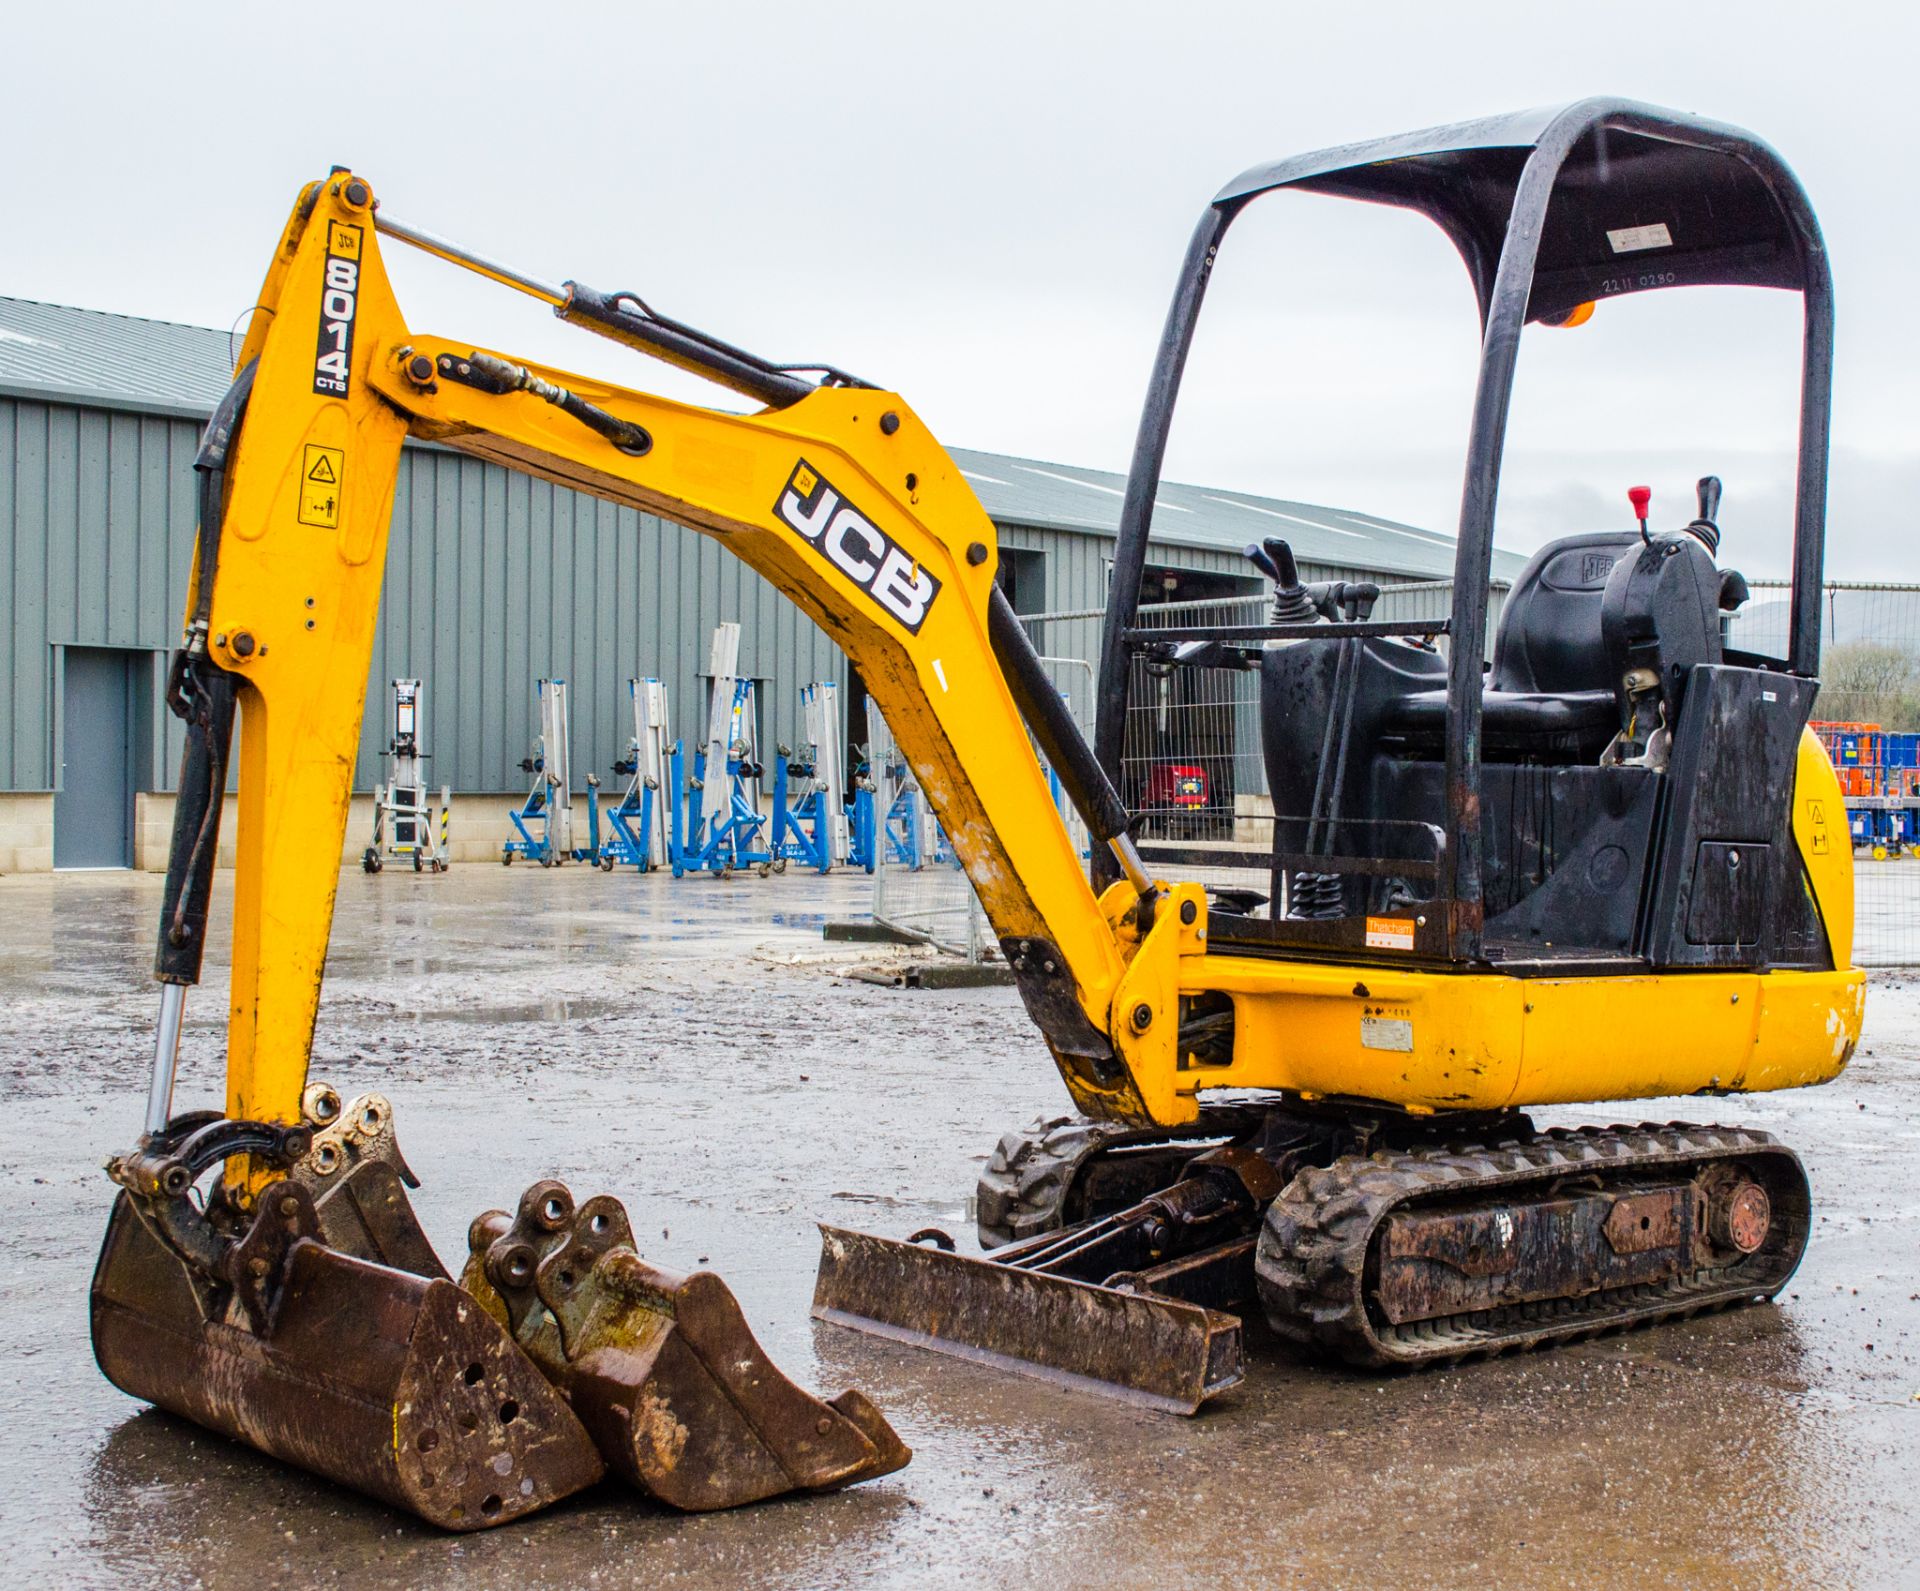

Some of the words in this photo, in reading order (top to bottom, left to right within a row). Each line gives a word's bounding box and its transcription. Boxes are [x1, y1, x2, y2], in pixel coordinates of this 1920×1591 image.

[316, 259, 358, 381] 8014
[316, 376, 347, 392] CTS
[781, 487, 934, 626] JCB
